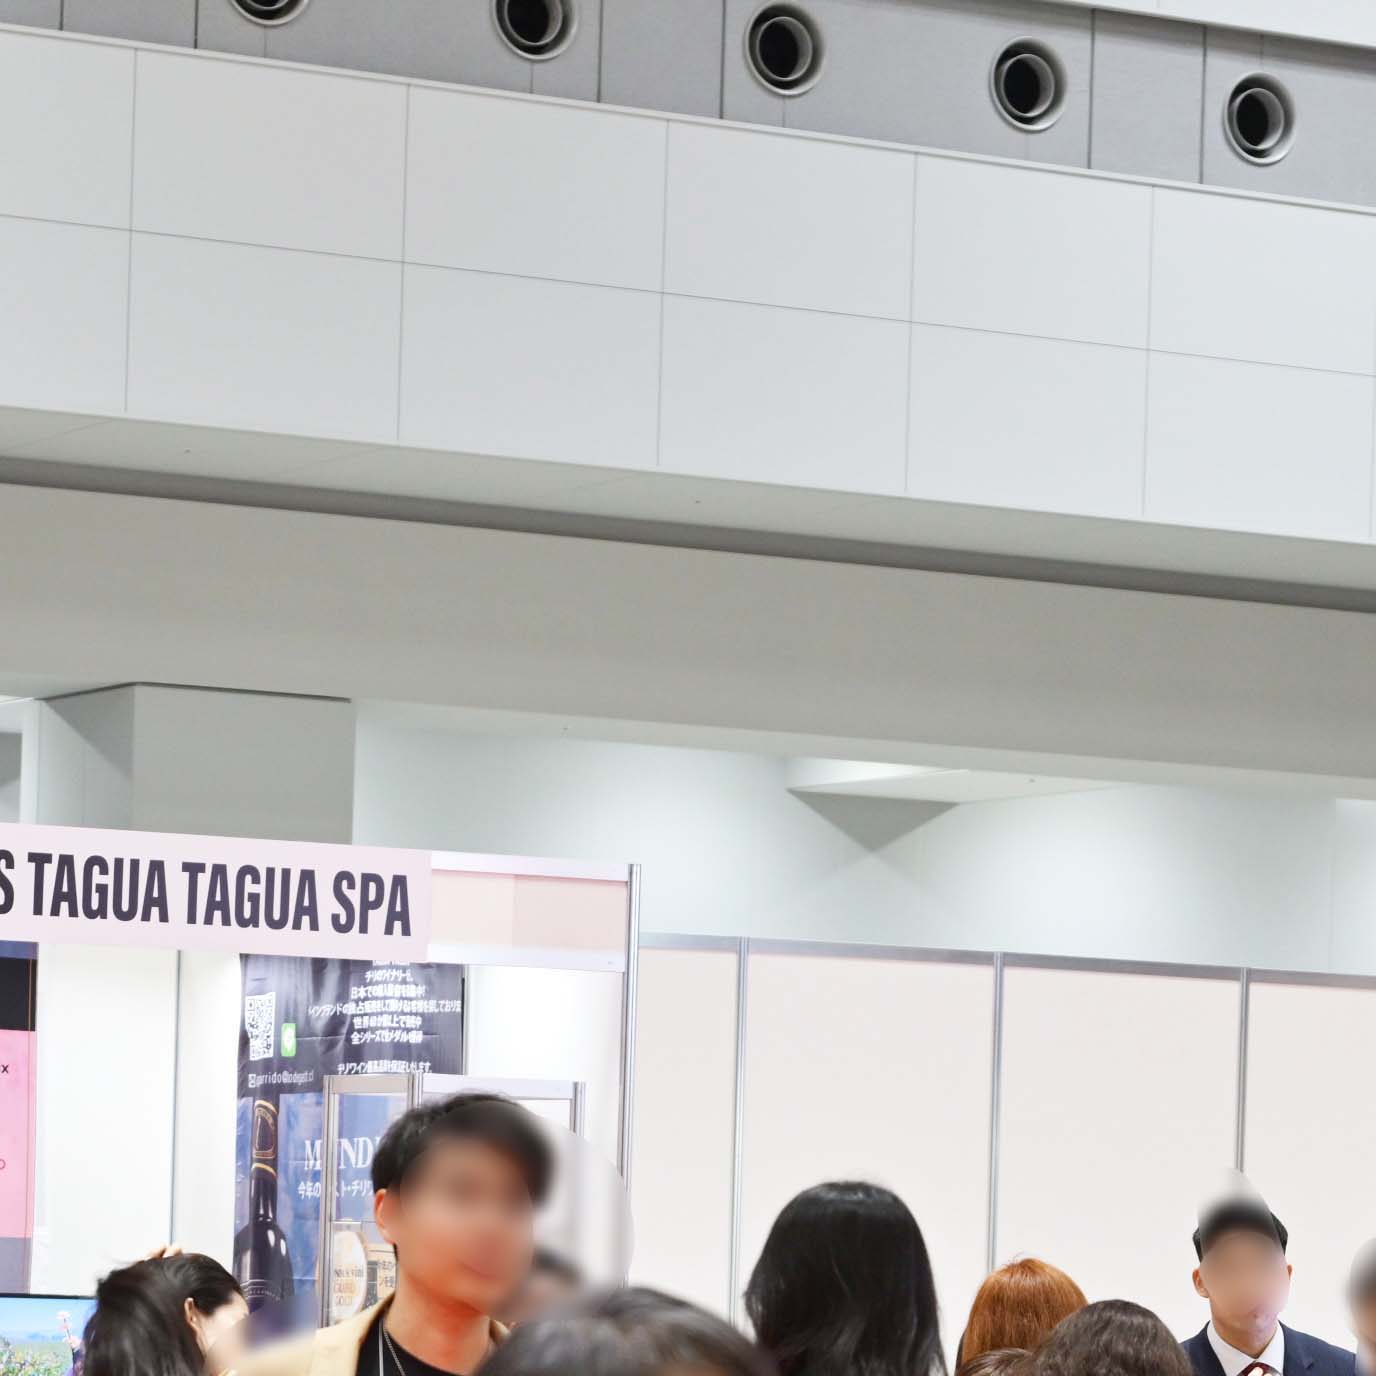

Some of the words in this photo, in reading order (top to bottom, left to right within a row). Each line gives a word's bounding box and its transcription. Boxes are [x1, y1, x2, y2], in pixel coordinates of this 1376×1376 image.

[27, 851, 169, 923] TAGUA
[182, 861, 320, 932] TAGUA
[331, 870, 412, 937] SPA
